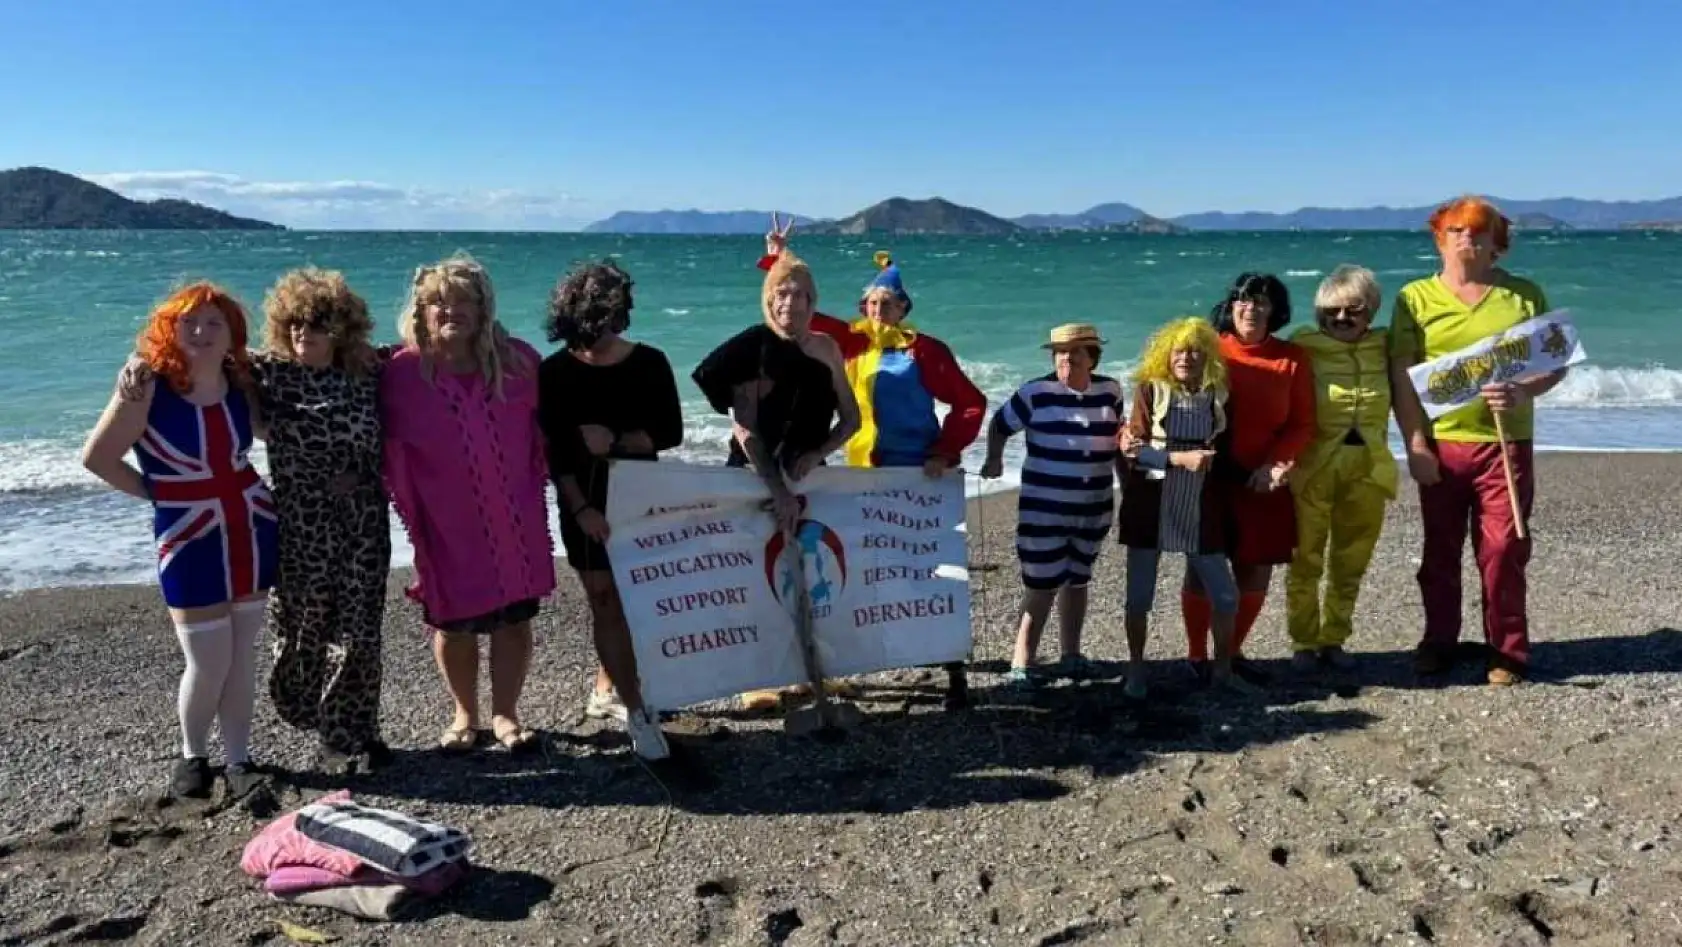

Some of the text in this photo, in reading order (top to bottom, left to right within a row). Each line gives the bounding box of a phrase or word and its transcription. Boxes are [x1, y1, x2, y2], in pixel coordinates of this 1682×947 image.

[634, 520, 734, 549] WELFARE
[630, 551, 754, 585] EDUCATION
[656, 587, 748, 616] SUPPORT
[661, 624, 759, 658] CHARITY
